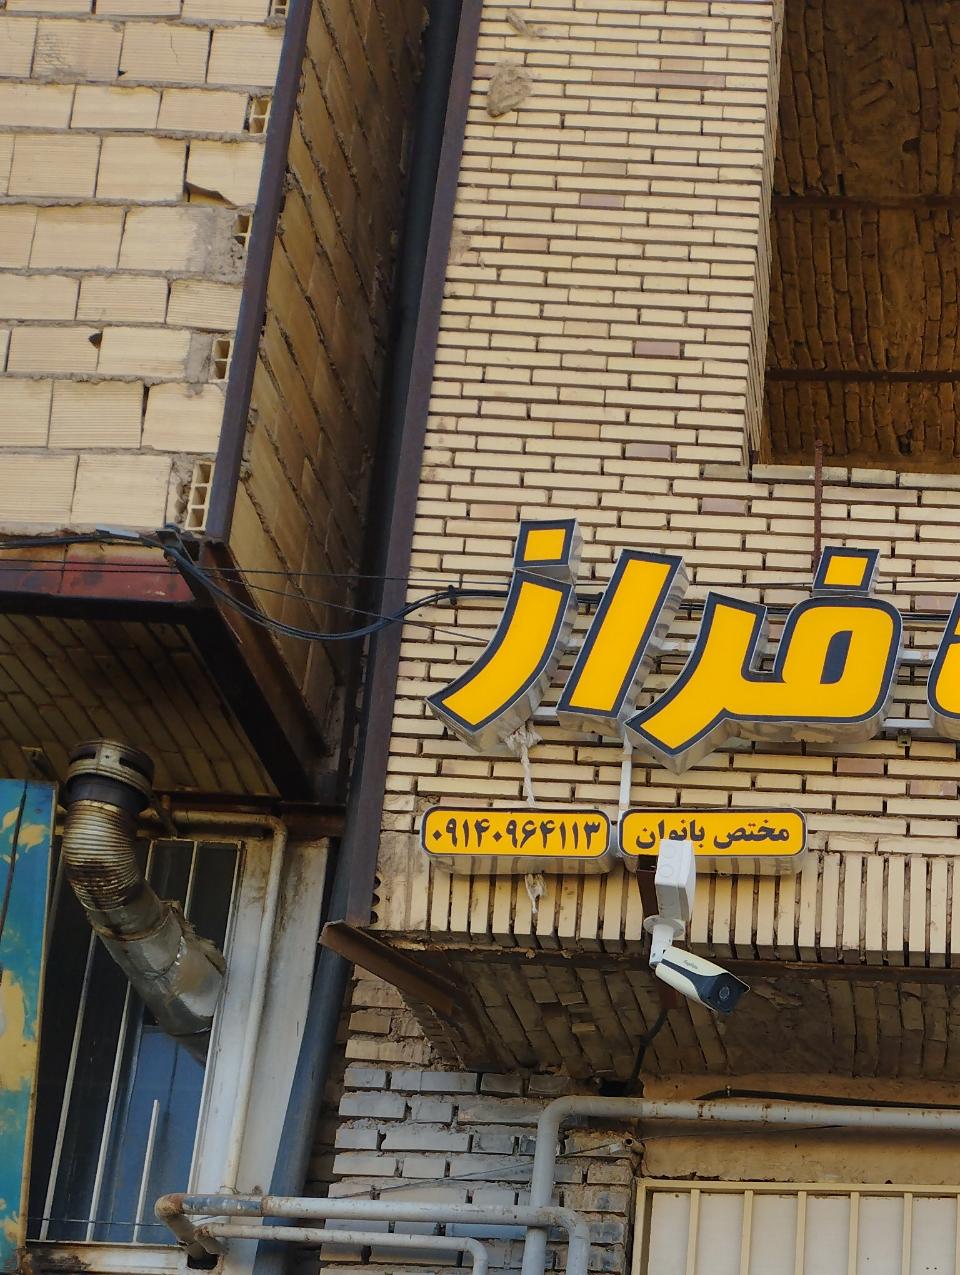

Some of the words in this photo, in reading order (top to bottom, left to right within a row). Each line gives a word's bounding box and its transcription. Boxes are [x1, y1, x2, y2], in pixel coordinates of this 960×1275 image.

[426, 519, 903, 758] فراز
[432, 818, 601, 850] ۰۹۱۴۰۹۶۴۱۱۳
[713, 819, 790, 850] مختص
